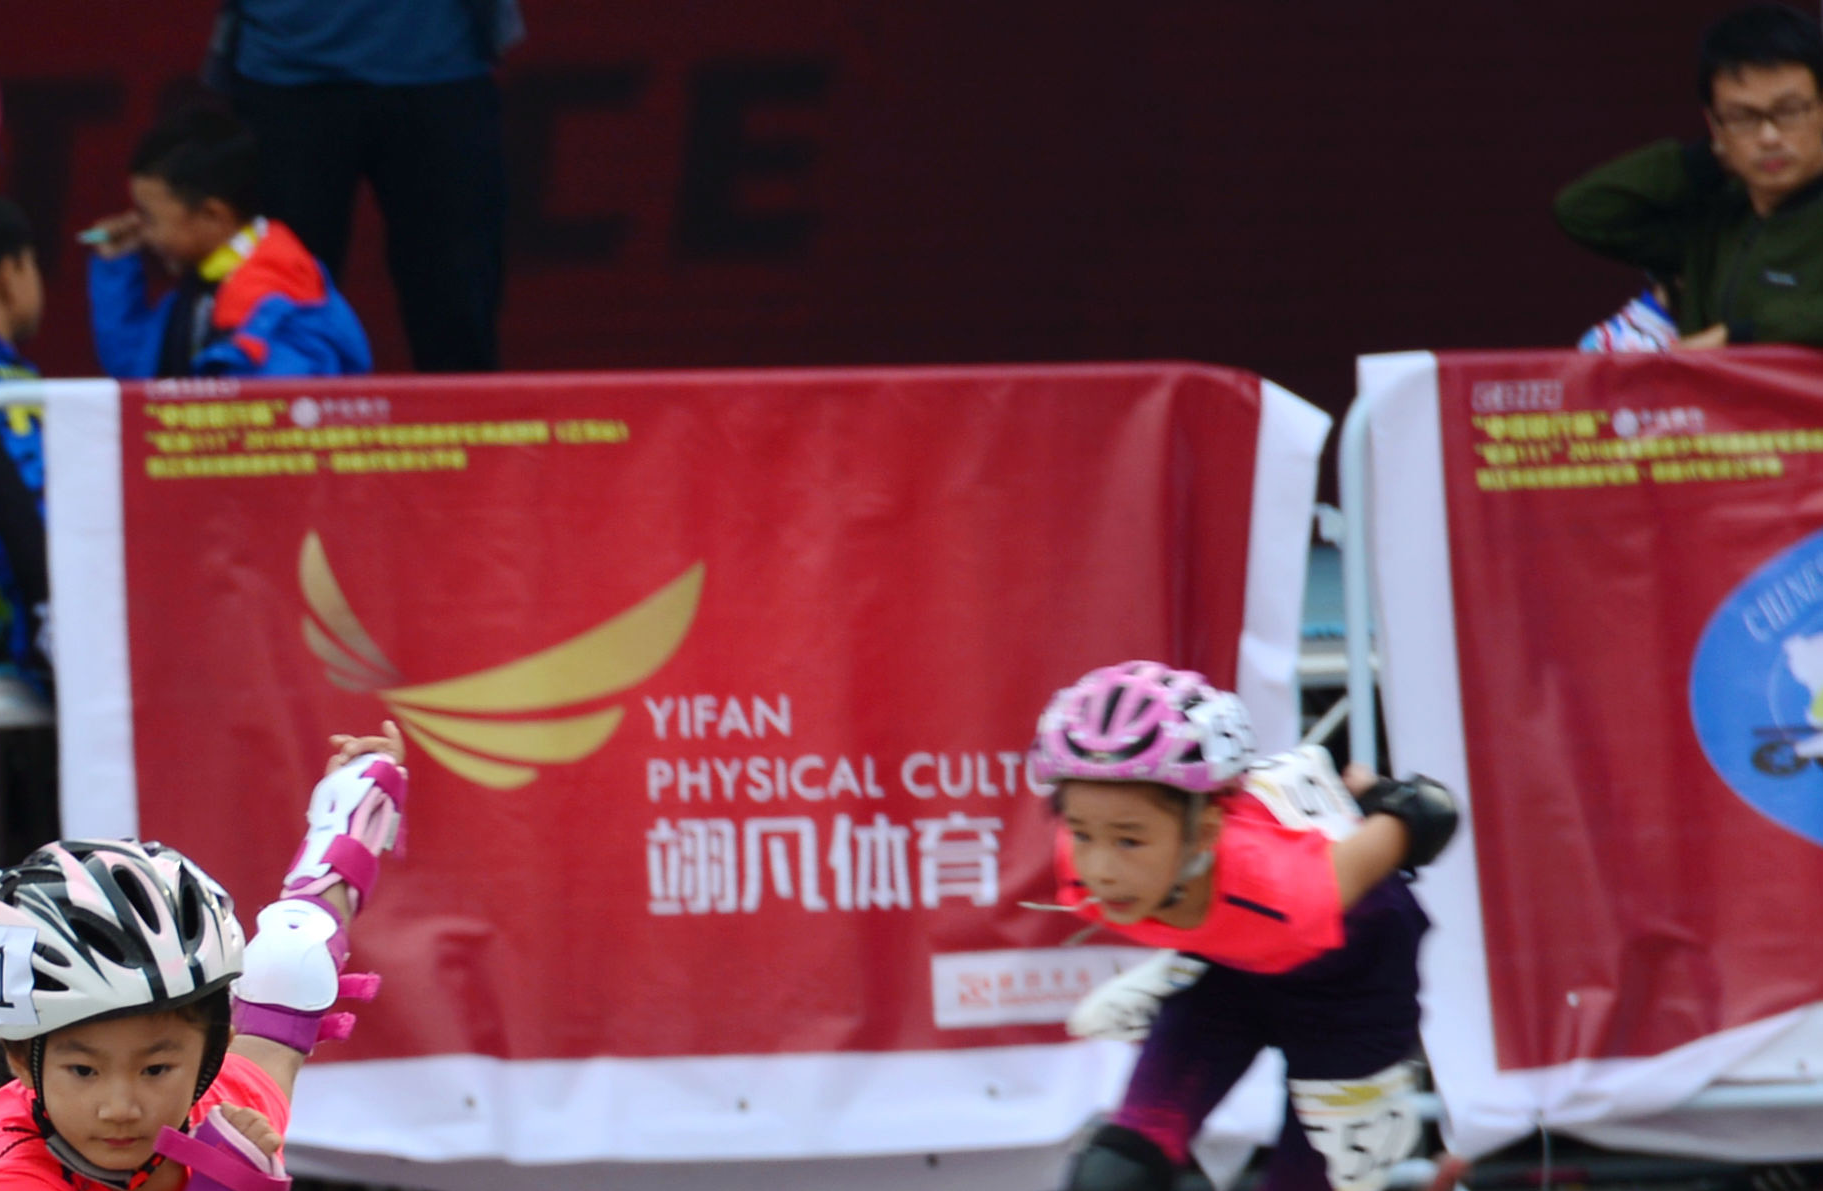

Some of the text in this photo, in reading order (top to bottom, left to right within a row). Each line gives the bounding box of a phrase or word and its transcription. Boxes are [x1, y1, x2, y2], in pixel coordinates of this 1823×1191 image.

[644, 693, 792, 740] YIFAN
[646, 754, 885, 802] PHYSICAL
[645, 812, 1004, 916] 翊凡体育
